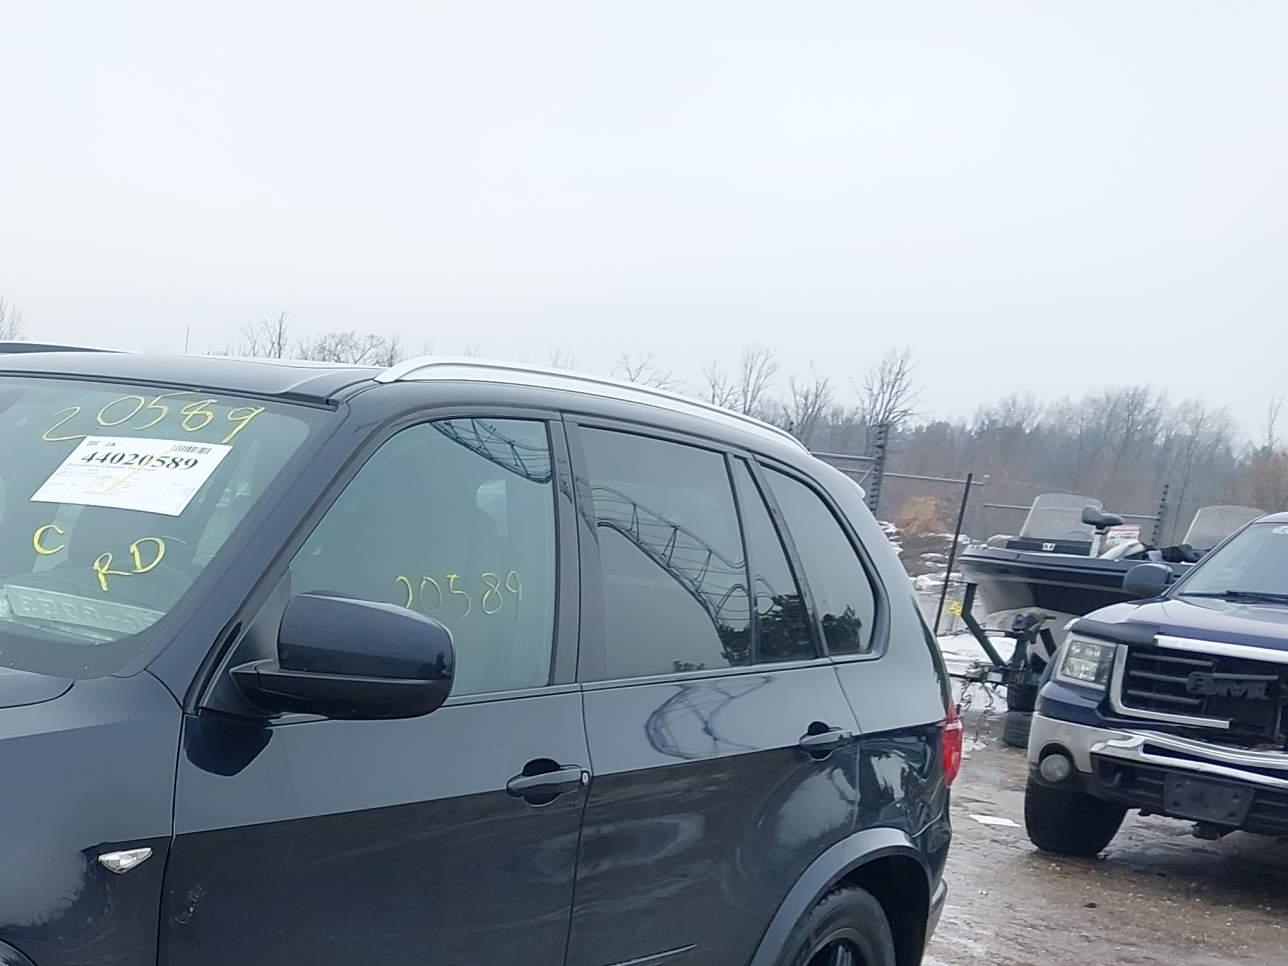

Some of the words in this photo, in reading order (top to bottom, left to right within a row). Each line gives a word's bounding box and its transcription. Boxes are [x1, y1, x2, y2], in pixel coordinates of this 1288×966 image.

[42, 392, 265, 444] 20589
[81, 451, 198, 470] 44020589
[33, 524, 65, 555] C
